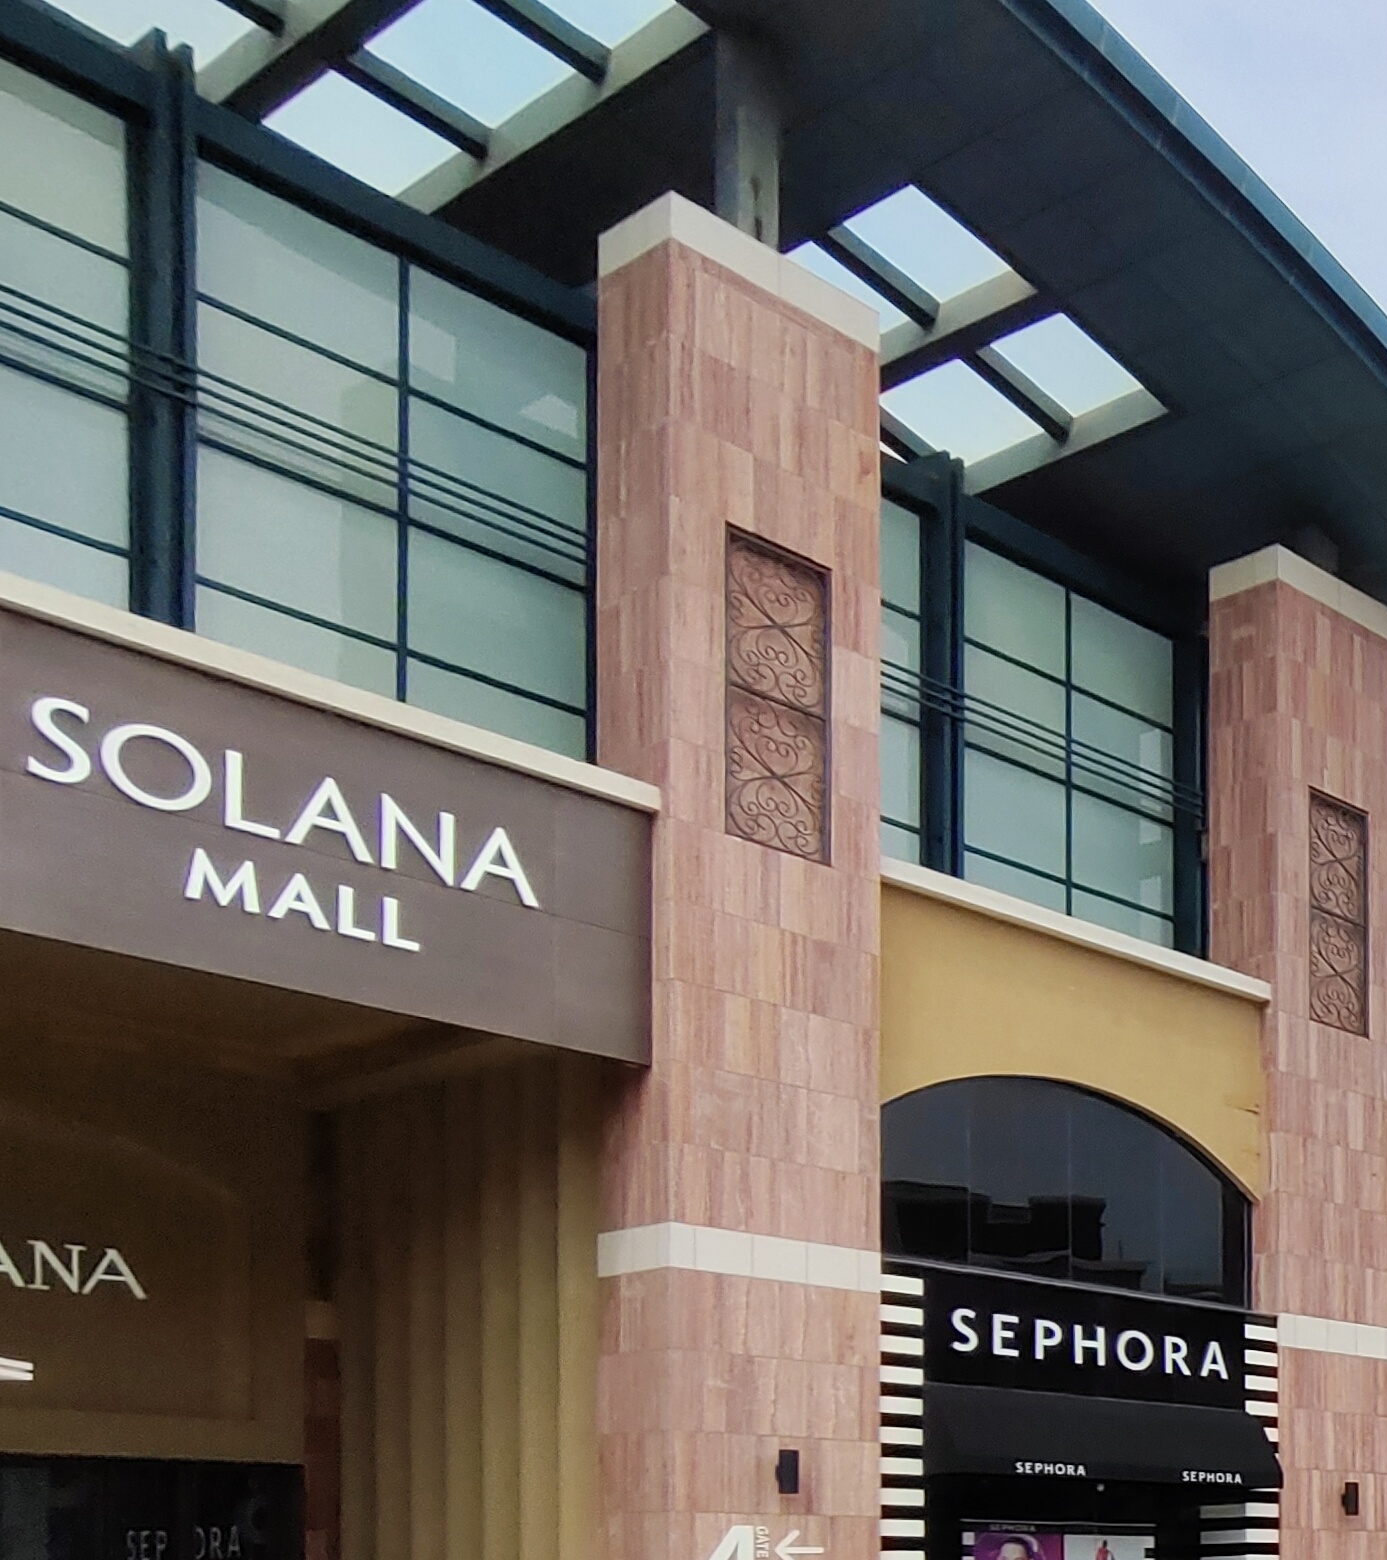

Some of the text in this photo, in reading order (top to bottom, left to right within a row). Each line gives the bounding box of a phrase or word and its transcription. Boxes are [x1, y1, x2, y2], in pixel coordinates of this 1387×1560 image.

[26, 697, 540, 909] SOLANA
[184, 848, 421, 952] MALL
[950, 1308, 1230, 1380] SEPHORA
[1014, 1461, 1087, 1477] SEPHORA
[1181, 1470, 1243, 1485] SEPHORA
[755, 1526, 770, 1559] GATE
